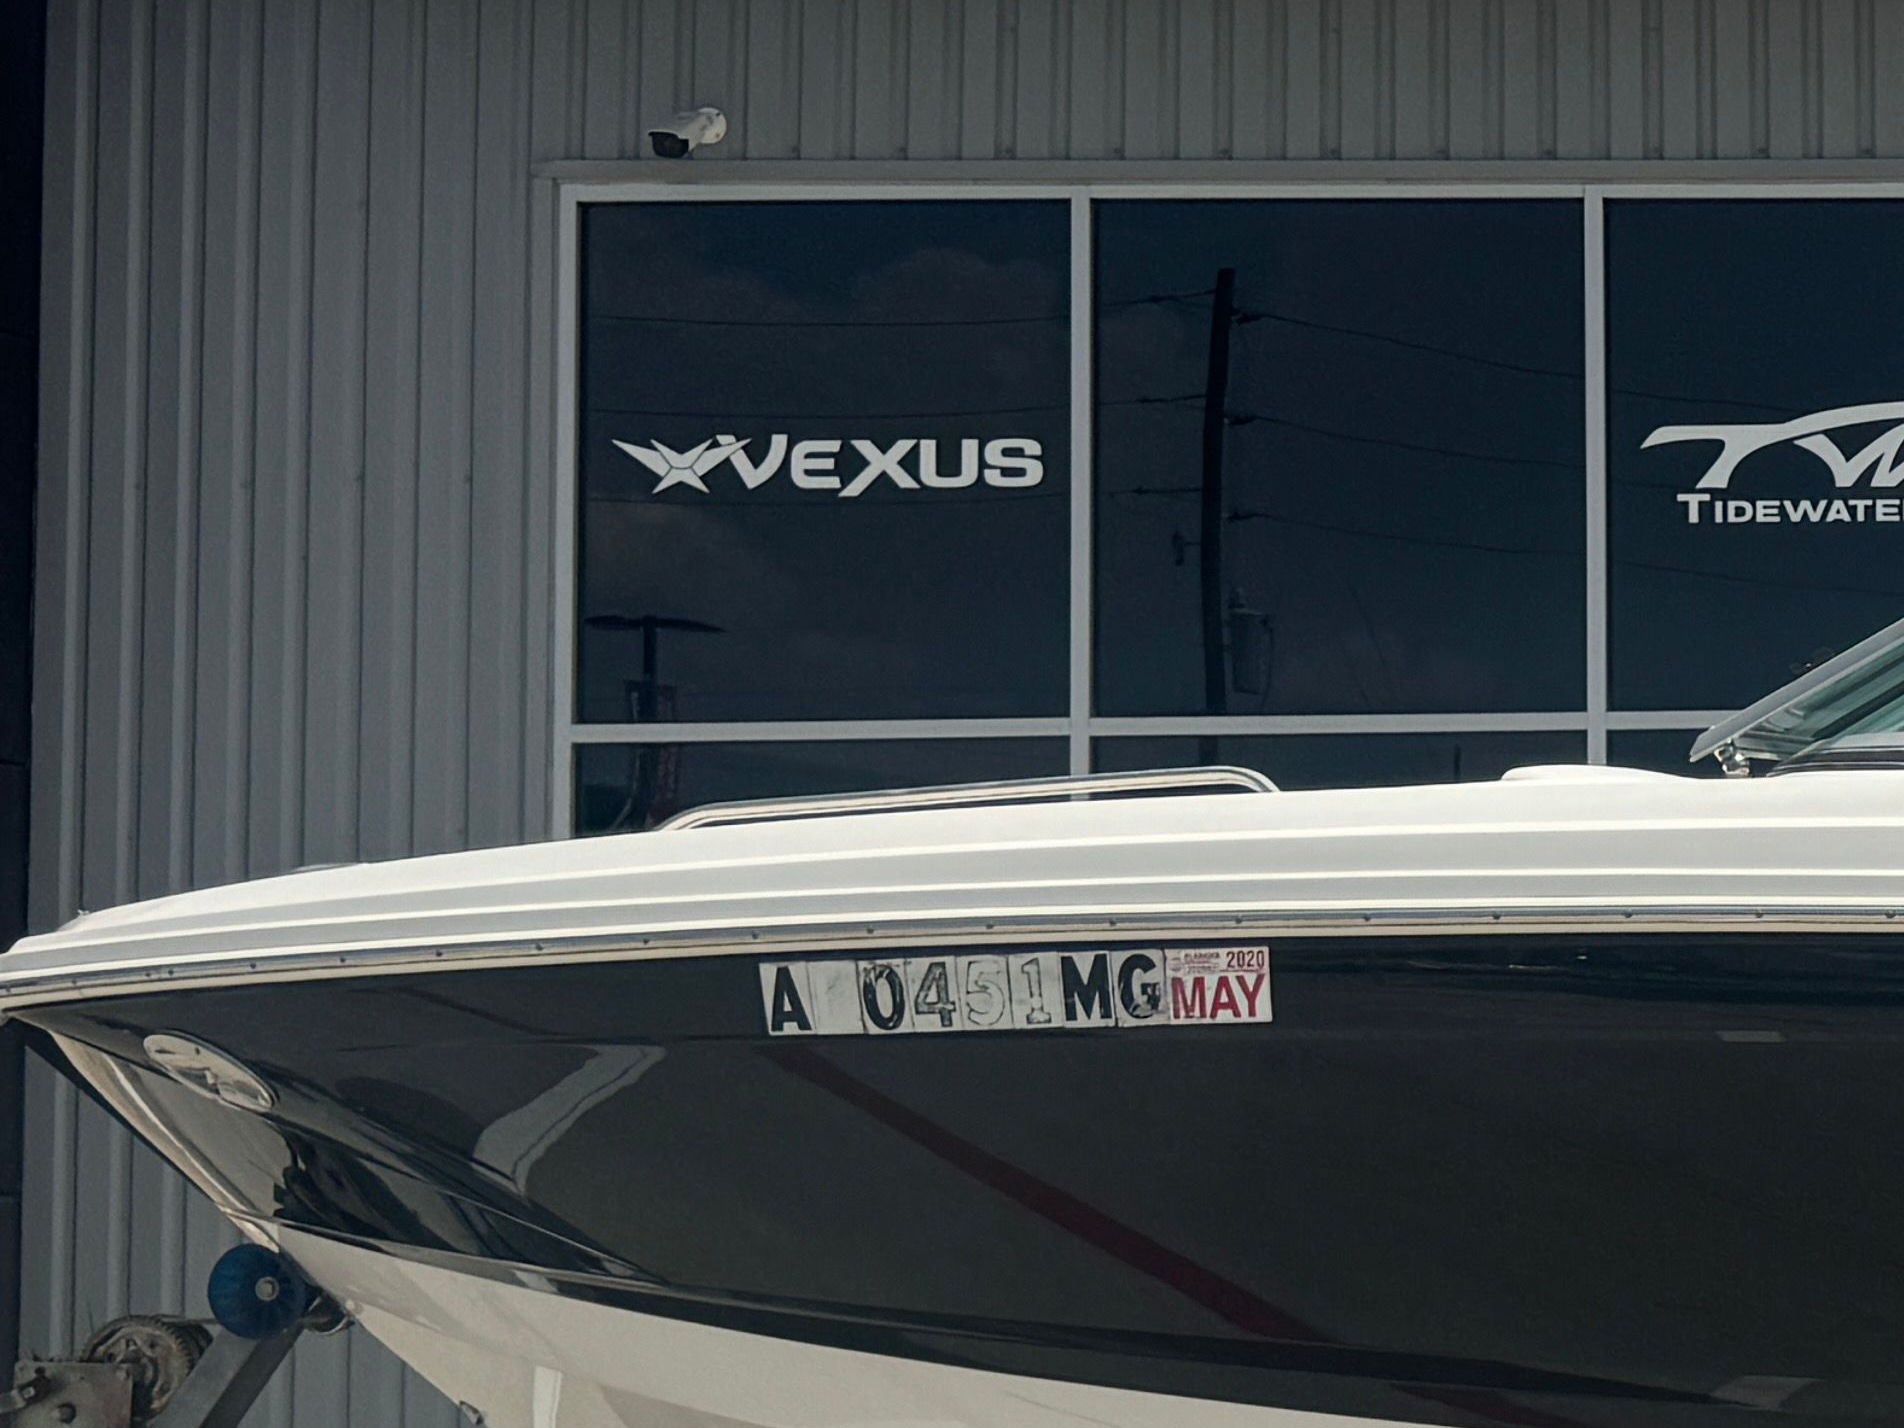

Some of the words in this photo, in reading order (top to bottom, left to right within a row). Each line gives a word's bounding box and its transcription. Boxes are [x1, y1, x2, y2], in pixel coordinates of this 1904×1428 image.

[716, 433, 1044, 498] VEXUS
[1225, 950, 1265, 969] 2020
[1171, 973, 1266, 1020] MAY
